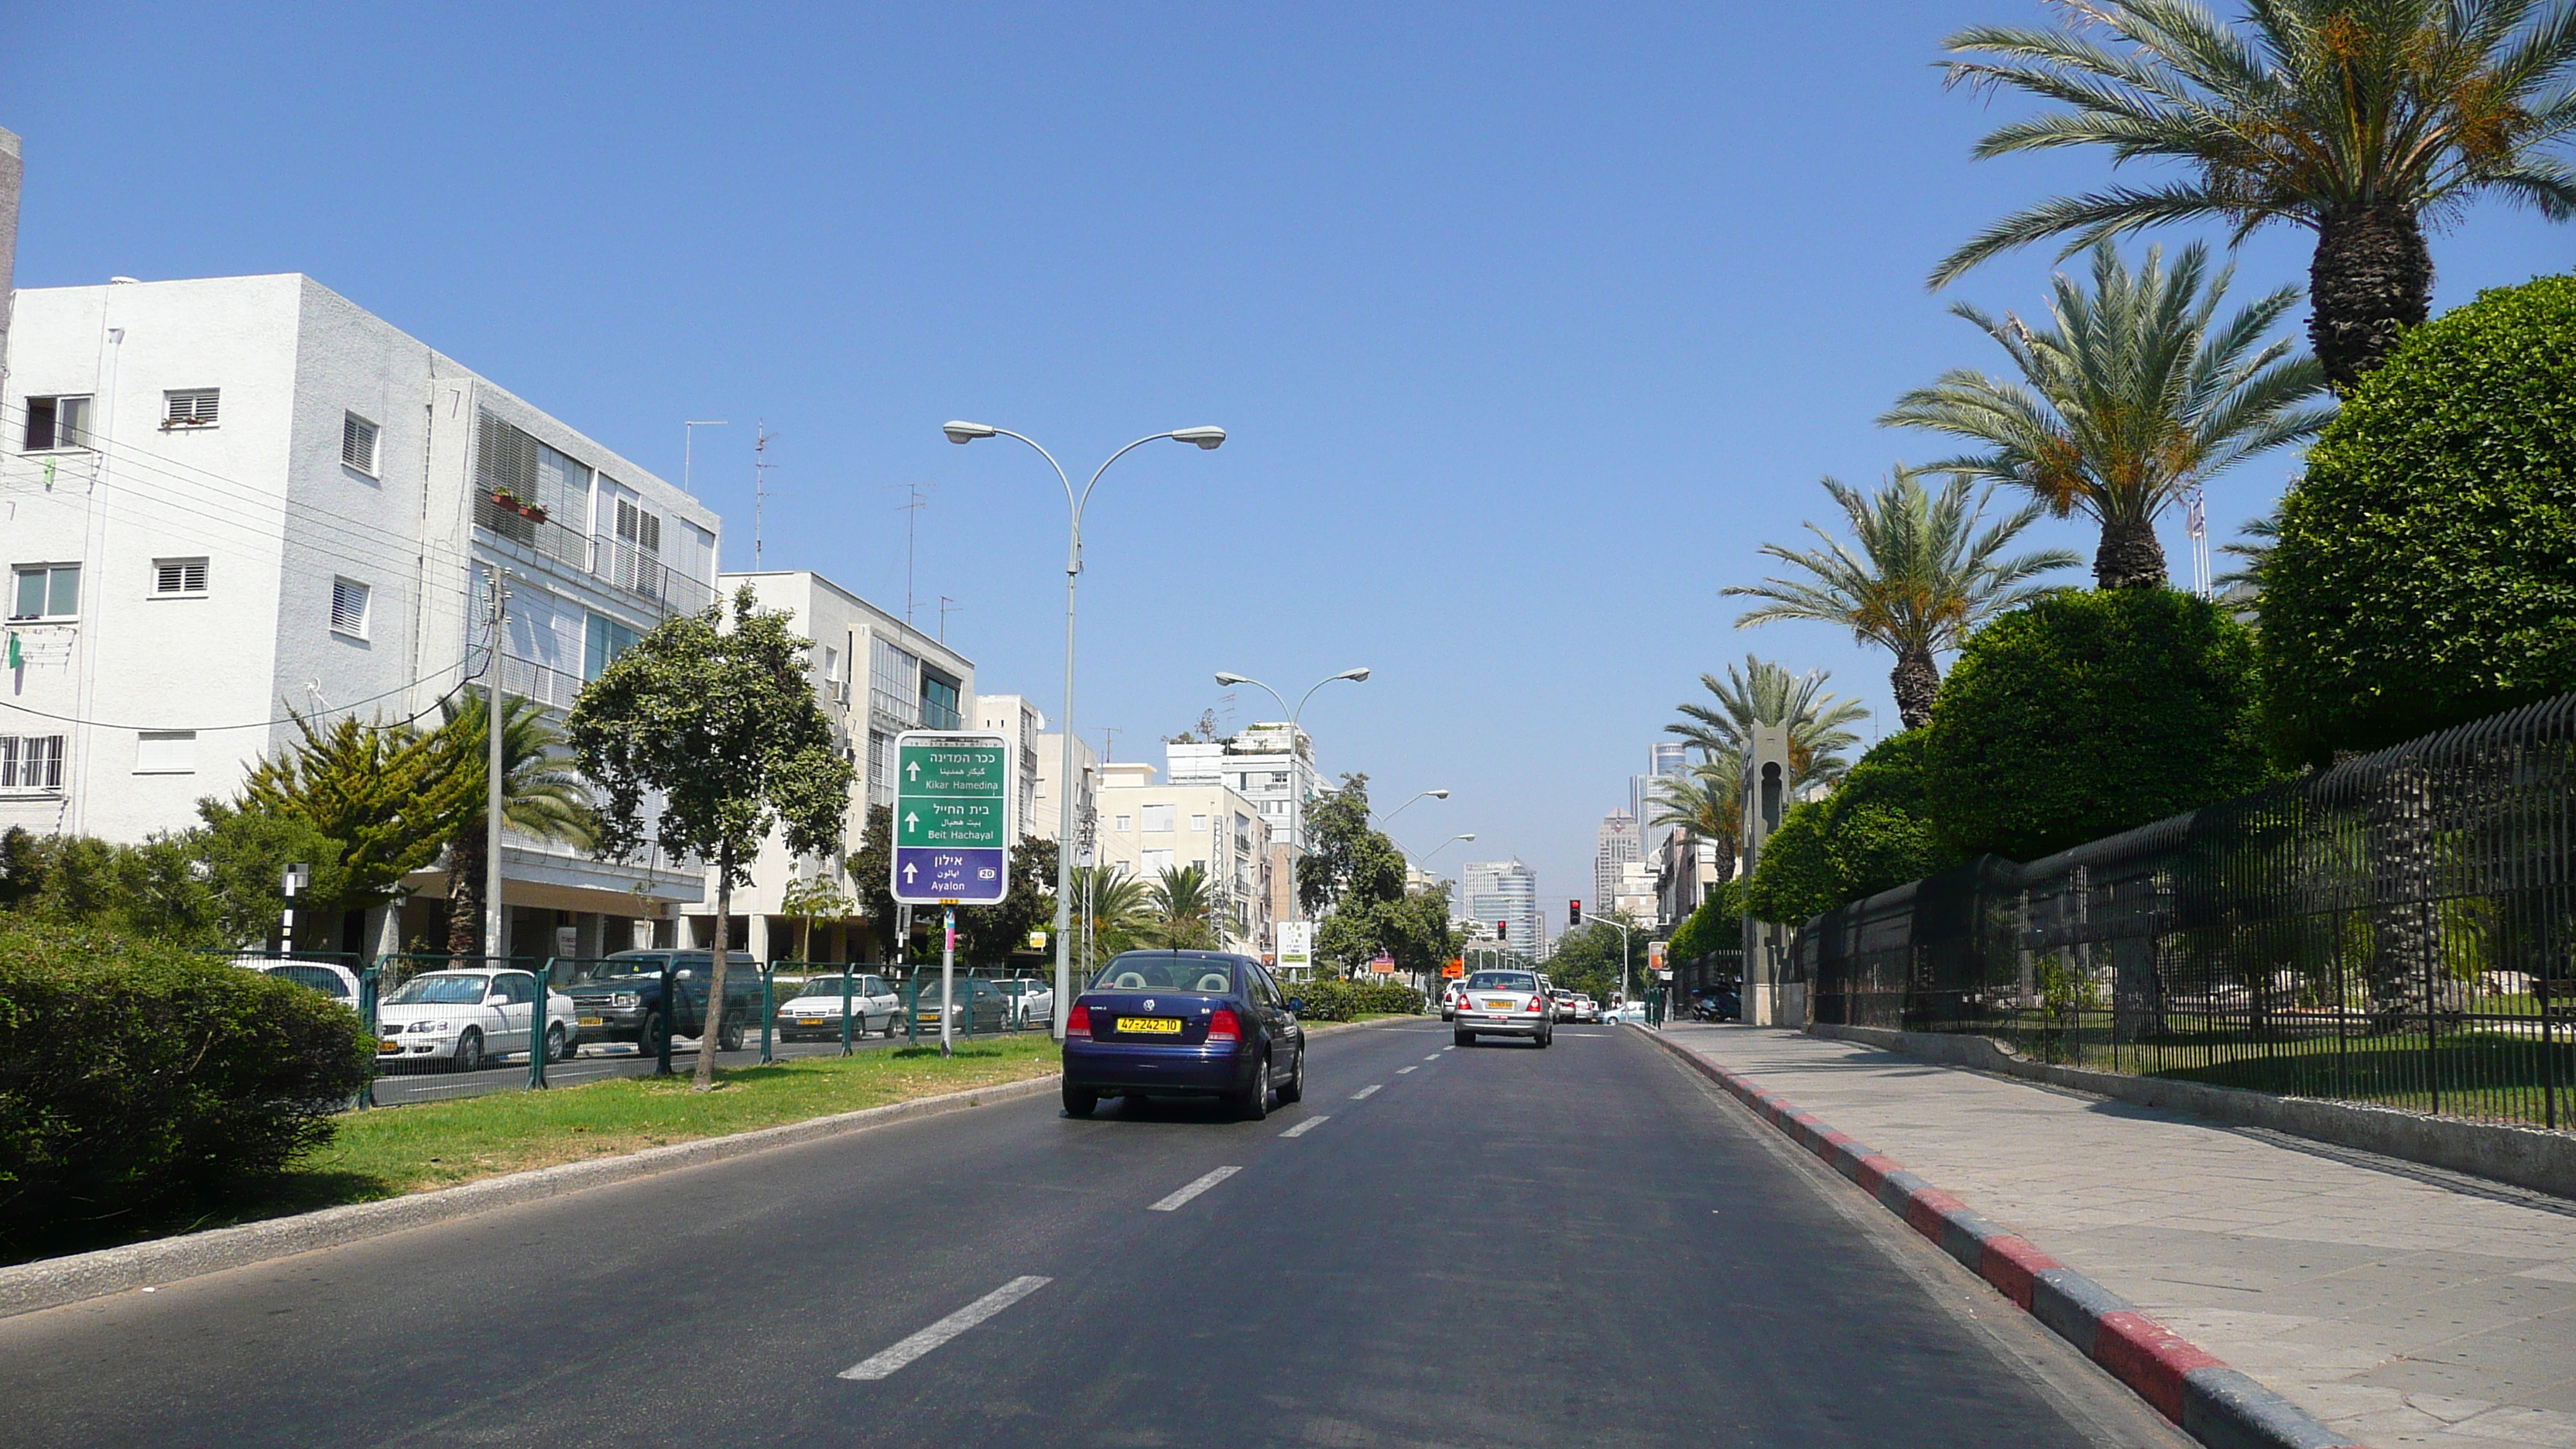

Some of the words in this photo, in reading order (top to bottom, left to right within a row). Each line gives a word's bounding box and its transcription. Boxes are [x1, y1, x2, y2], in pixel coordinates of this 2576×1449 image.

[930, 753, 970, 763] המדינה
[975, 754, 995, 763] ככר
[926, 780, 949, 790] Kikar
[953, 781, 999, 790] Hamedina
[933, 803, 964, 815] החייל
[969, 806, 989, 815] בית
[928, 831, 947, 840] Beit
[951, 831, 994, 841] Hachayal
[934, 855, 963, 868] אילון
[931, 881, 965, 892] Ayalon
[1122, 1019, 1177, 1030] 47-242-10
